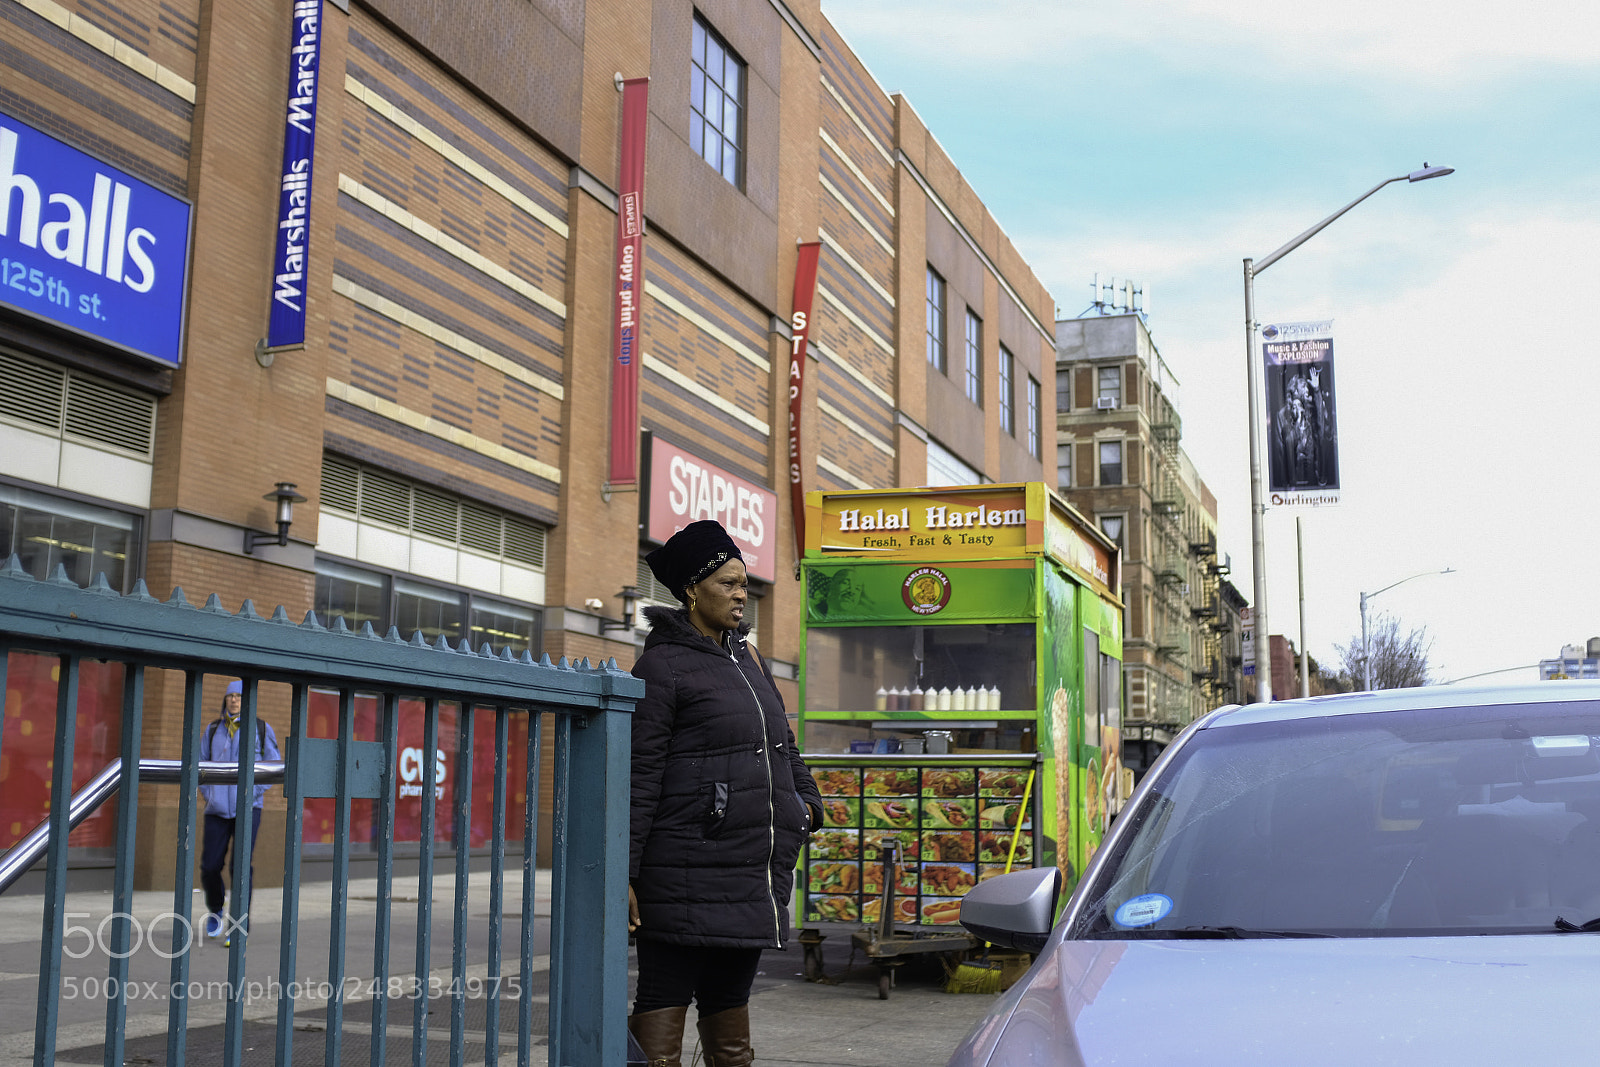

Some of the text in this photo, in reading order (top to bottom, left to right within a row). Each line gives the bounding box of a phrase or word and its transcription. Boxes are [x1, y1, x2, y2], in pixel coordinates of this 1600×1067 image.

[625, 196, 636, 235] STAPLES
[275, 158, 309, 312] Marshalls
[1, 258, 106, 321] 125th st.
[618, 328, 634, 365] shop
[1268, 341, 1330, 353] Music & Fashion
[1278, 350, 1319, 361] EXPLOSION
[789, 311, 807, 484] STAPLES
[669, 455, 764, 547] STAPLES
[1272, 494, 1338, 507] Burlington
[840, 504, 1026, 531] Halal Harlem
[863, 533, 994, 548] Fresh, Fast & Tasty
[905, 569, 948, 586] HARLEM HALAL
